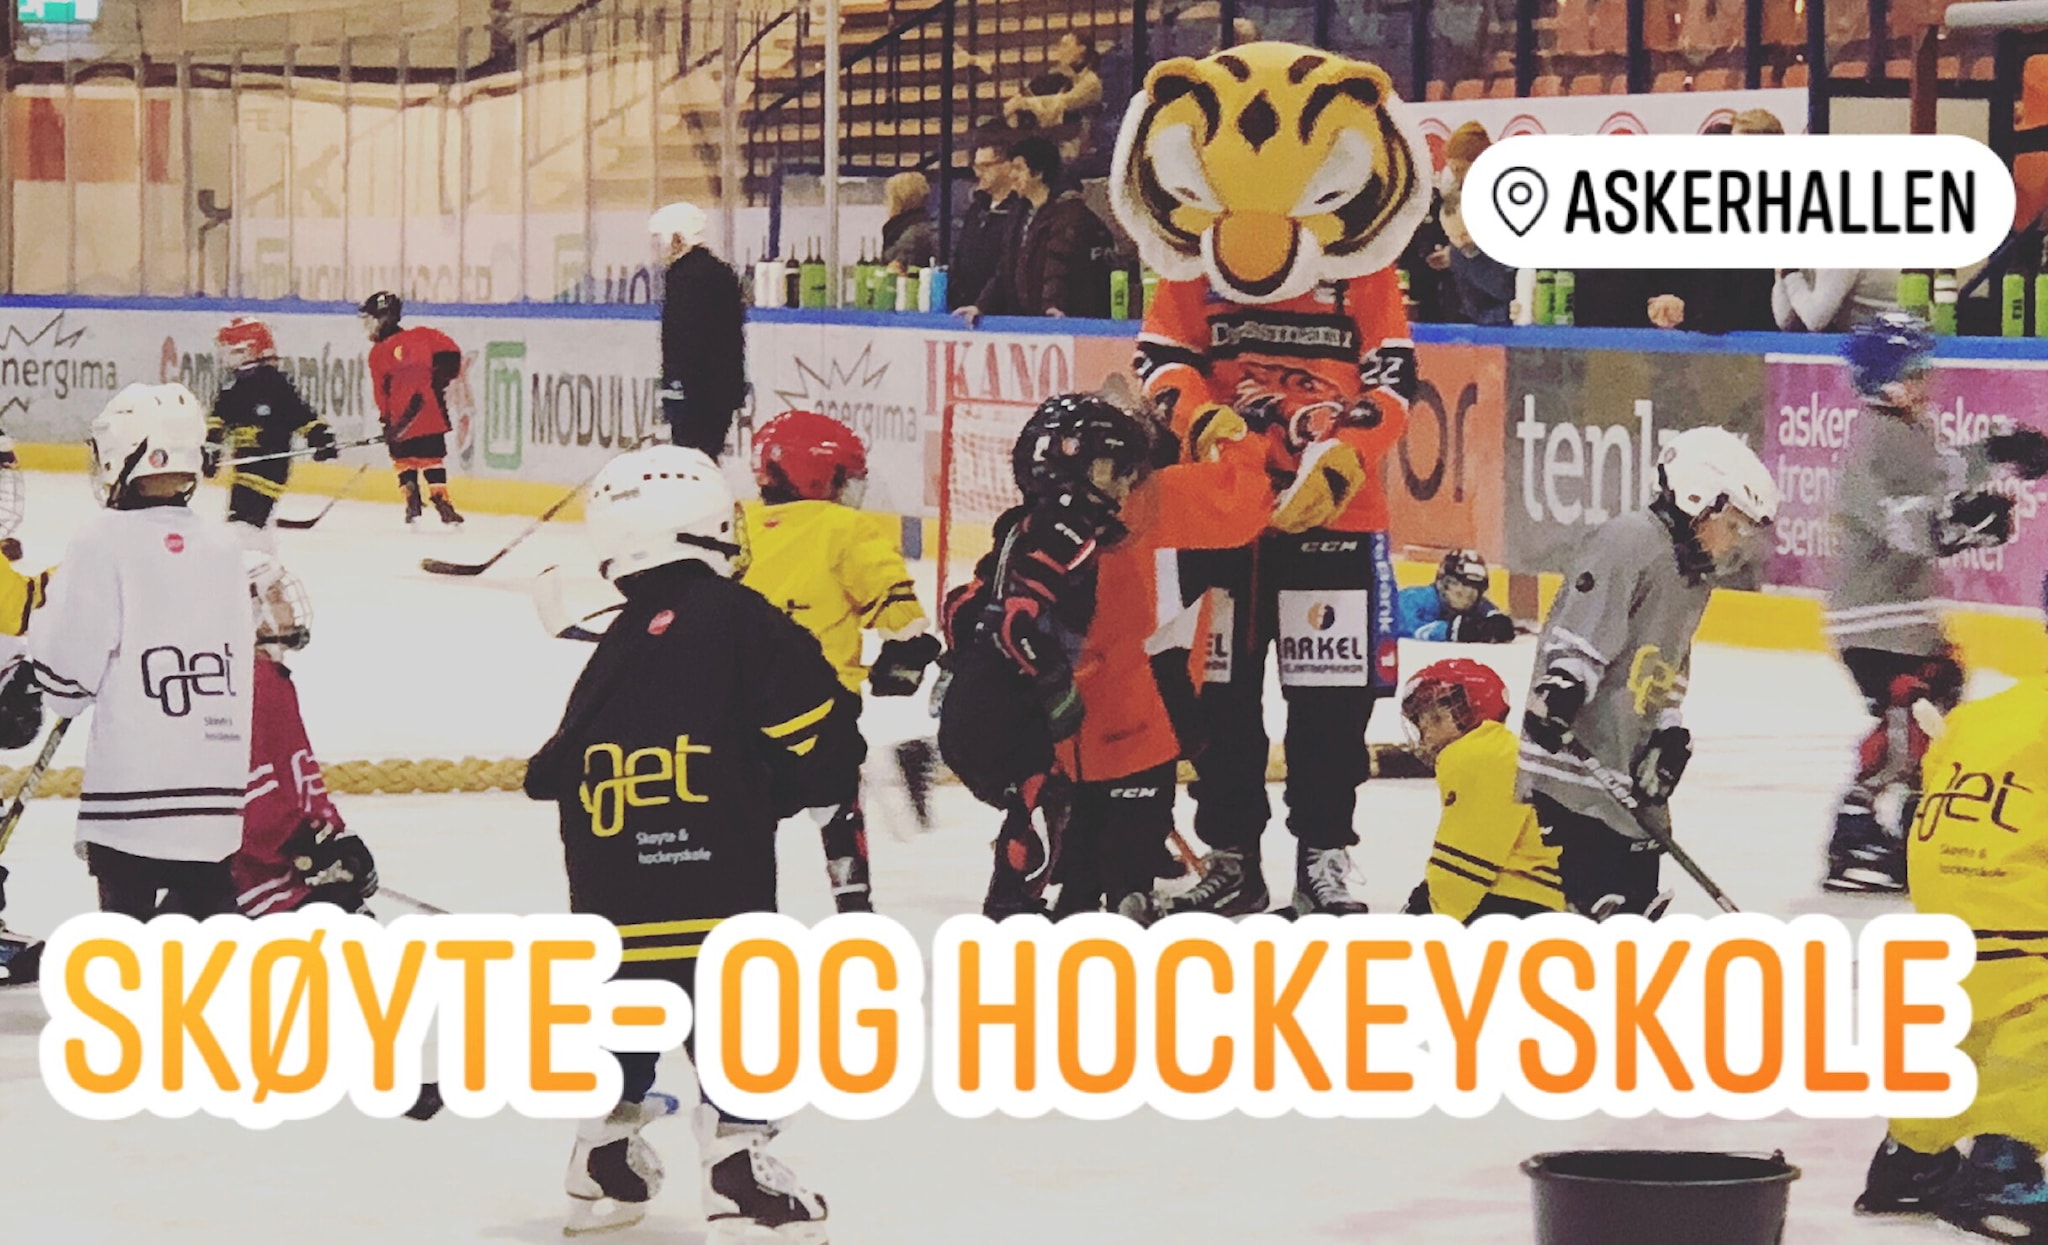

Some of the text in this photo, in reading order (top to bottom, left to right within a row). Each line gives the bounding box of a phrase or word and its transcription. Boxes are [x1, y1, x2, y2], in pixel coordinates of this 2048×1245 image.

[0, 357, 118, 400] nergima
[924, 340, 1069, 416] IKANO
[1360, 349, 1403, 385] 22
[1778, 392, 1859, 448] asker
[579, 734, 712, 837] get
